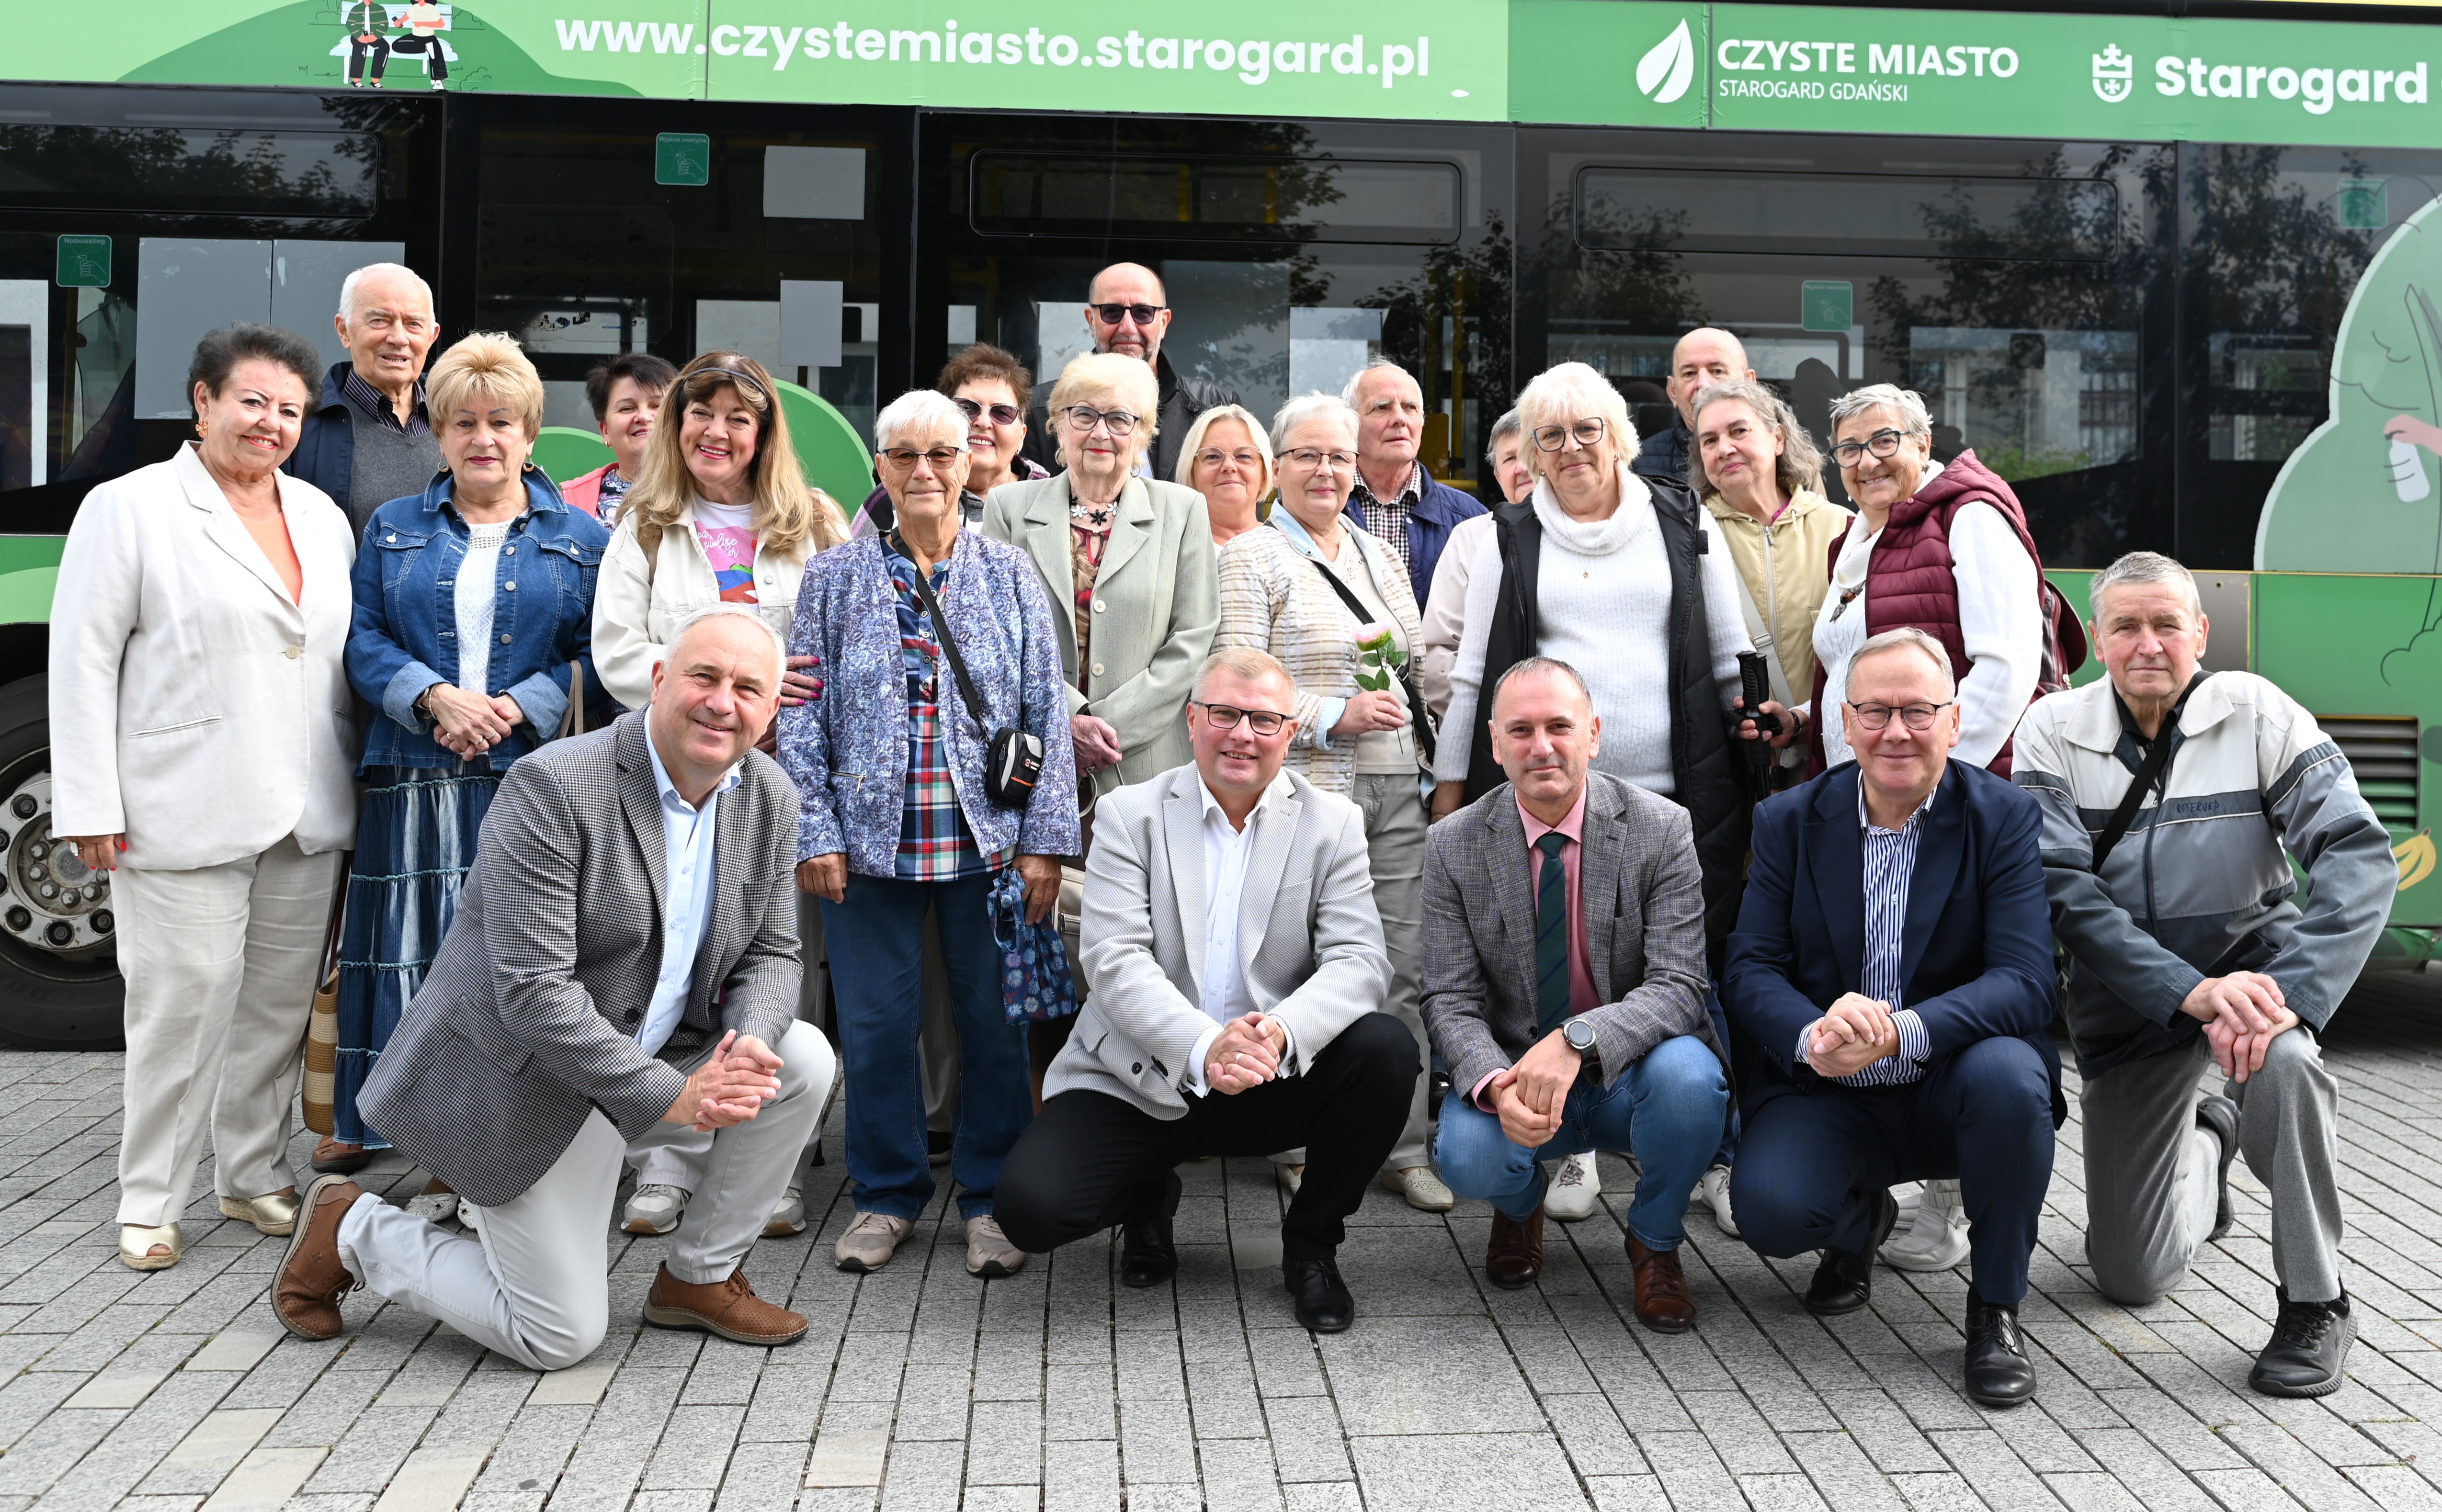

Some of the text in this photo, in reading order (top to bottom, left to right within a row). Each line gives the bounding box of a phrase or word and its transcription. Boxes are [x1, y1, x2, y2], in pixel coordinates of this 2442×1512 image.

[555, 20, 1428, 88] www.czystemiasto.starogard.pl
[1718, 40, 2018, 77] CZYSTE MIASTO
[1720, 80, 1907, 101] STAROGARD GDAŃSKI
[2156, 56, 2427, 114] Starogard
[2177, 799, 2219, 813] RESERVED
